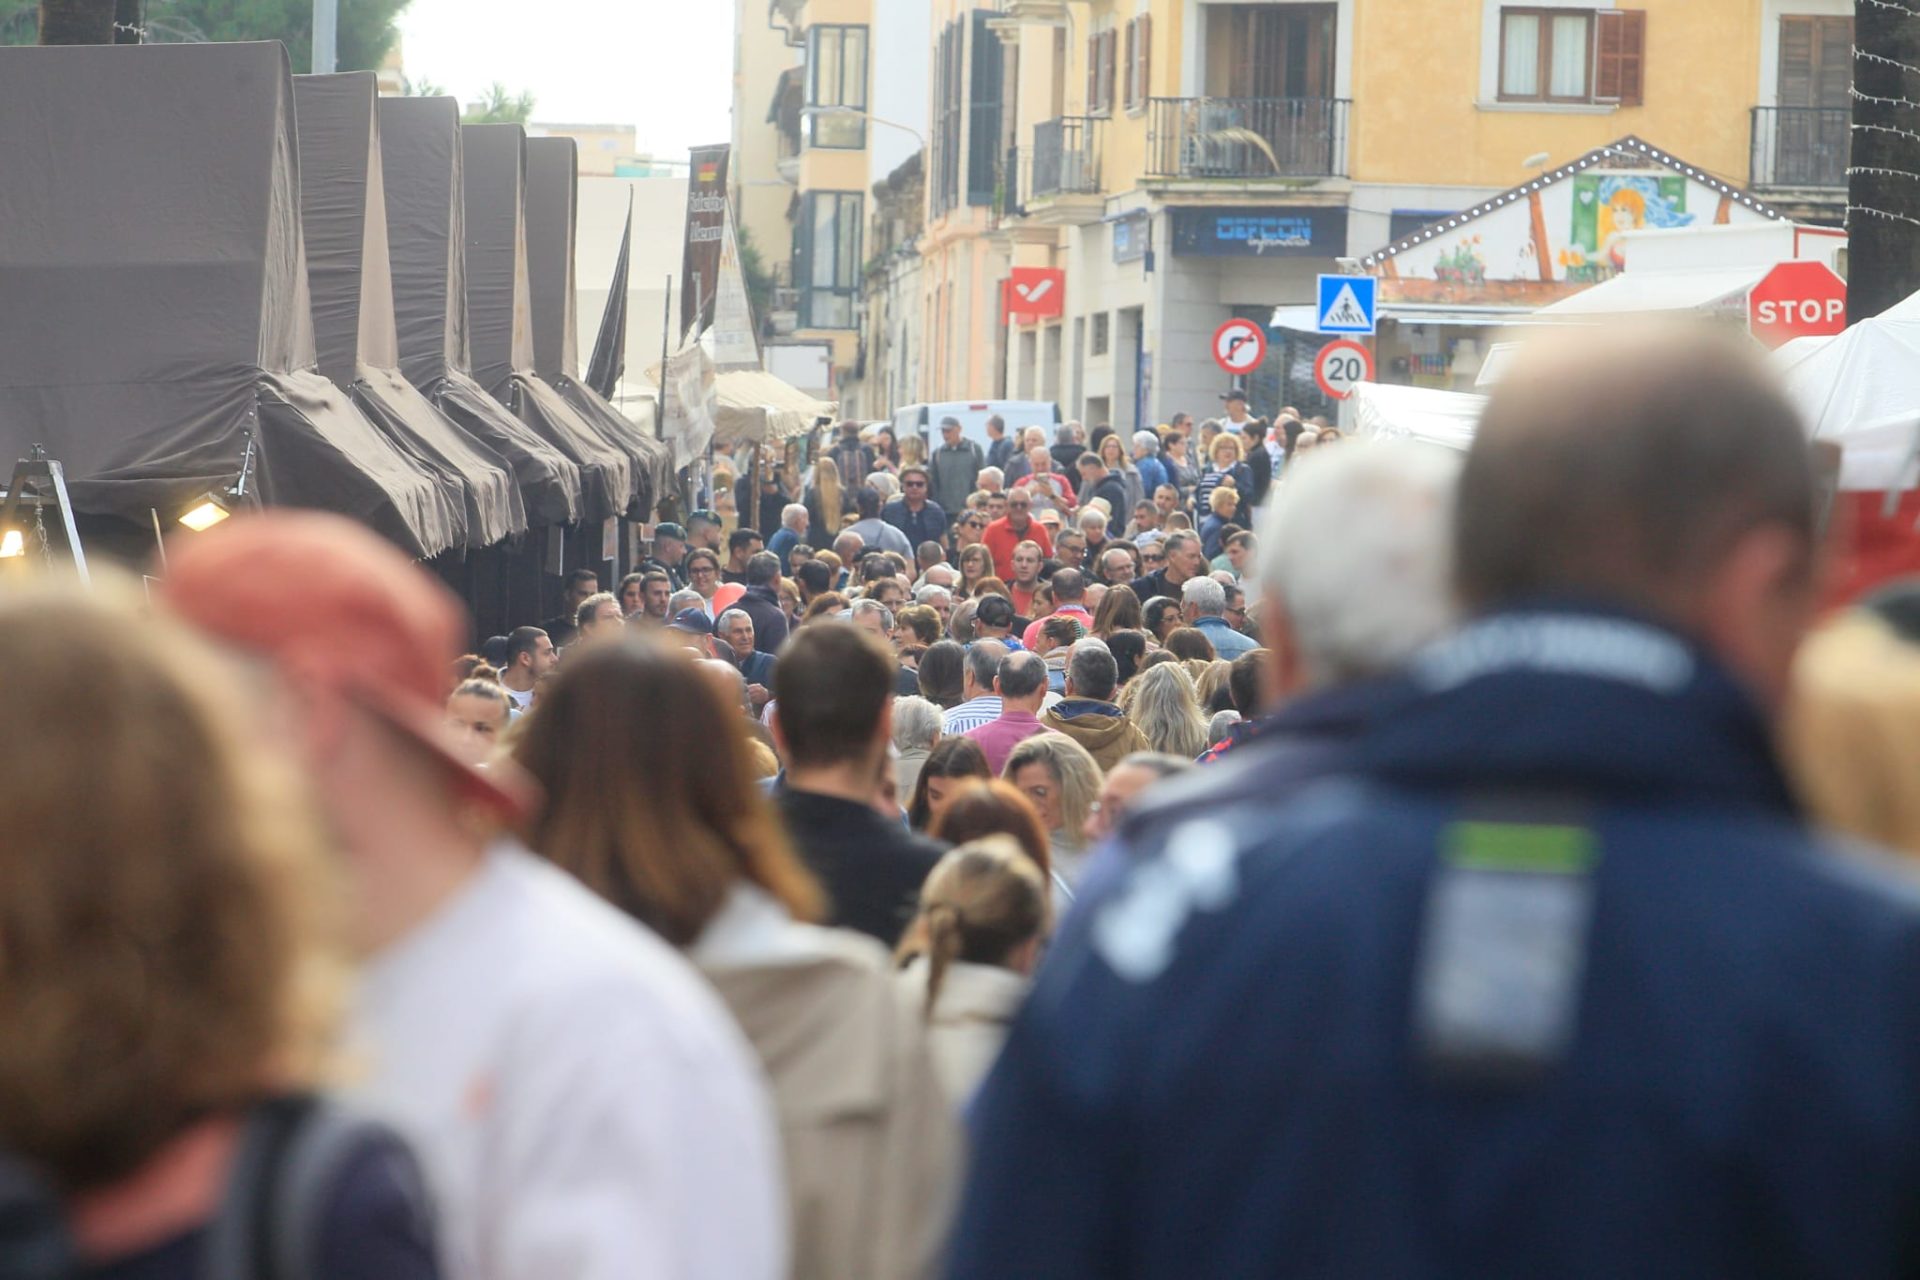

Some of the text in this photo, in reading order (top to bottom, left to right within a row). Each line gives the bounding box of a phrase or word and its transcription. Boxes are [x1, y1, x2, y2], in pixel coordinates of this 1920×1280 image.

[1216, 217, 1312, 240] DEFCON
[1758, 299, 1844, 324] STOP
[1328, 357, 1361, 381] 20
